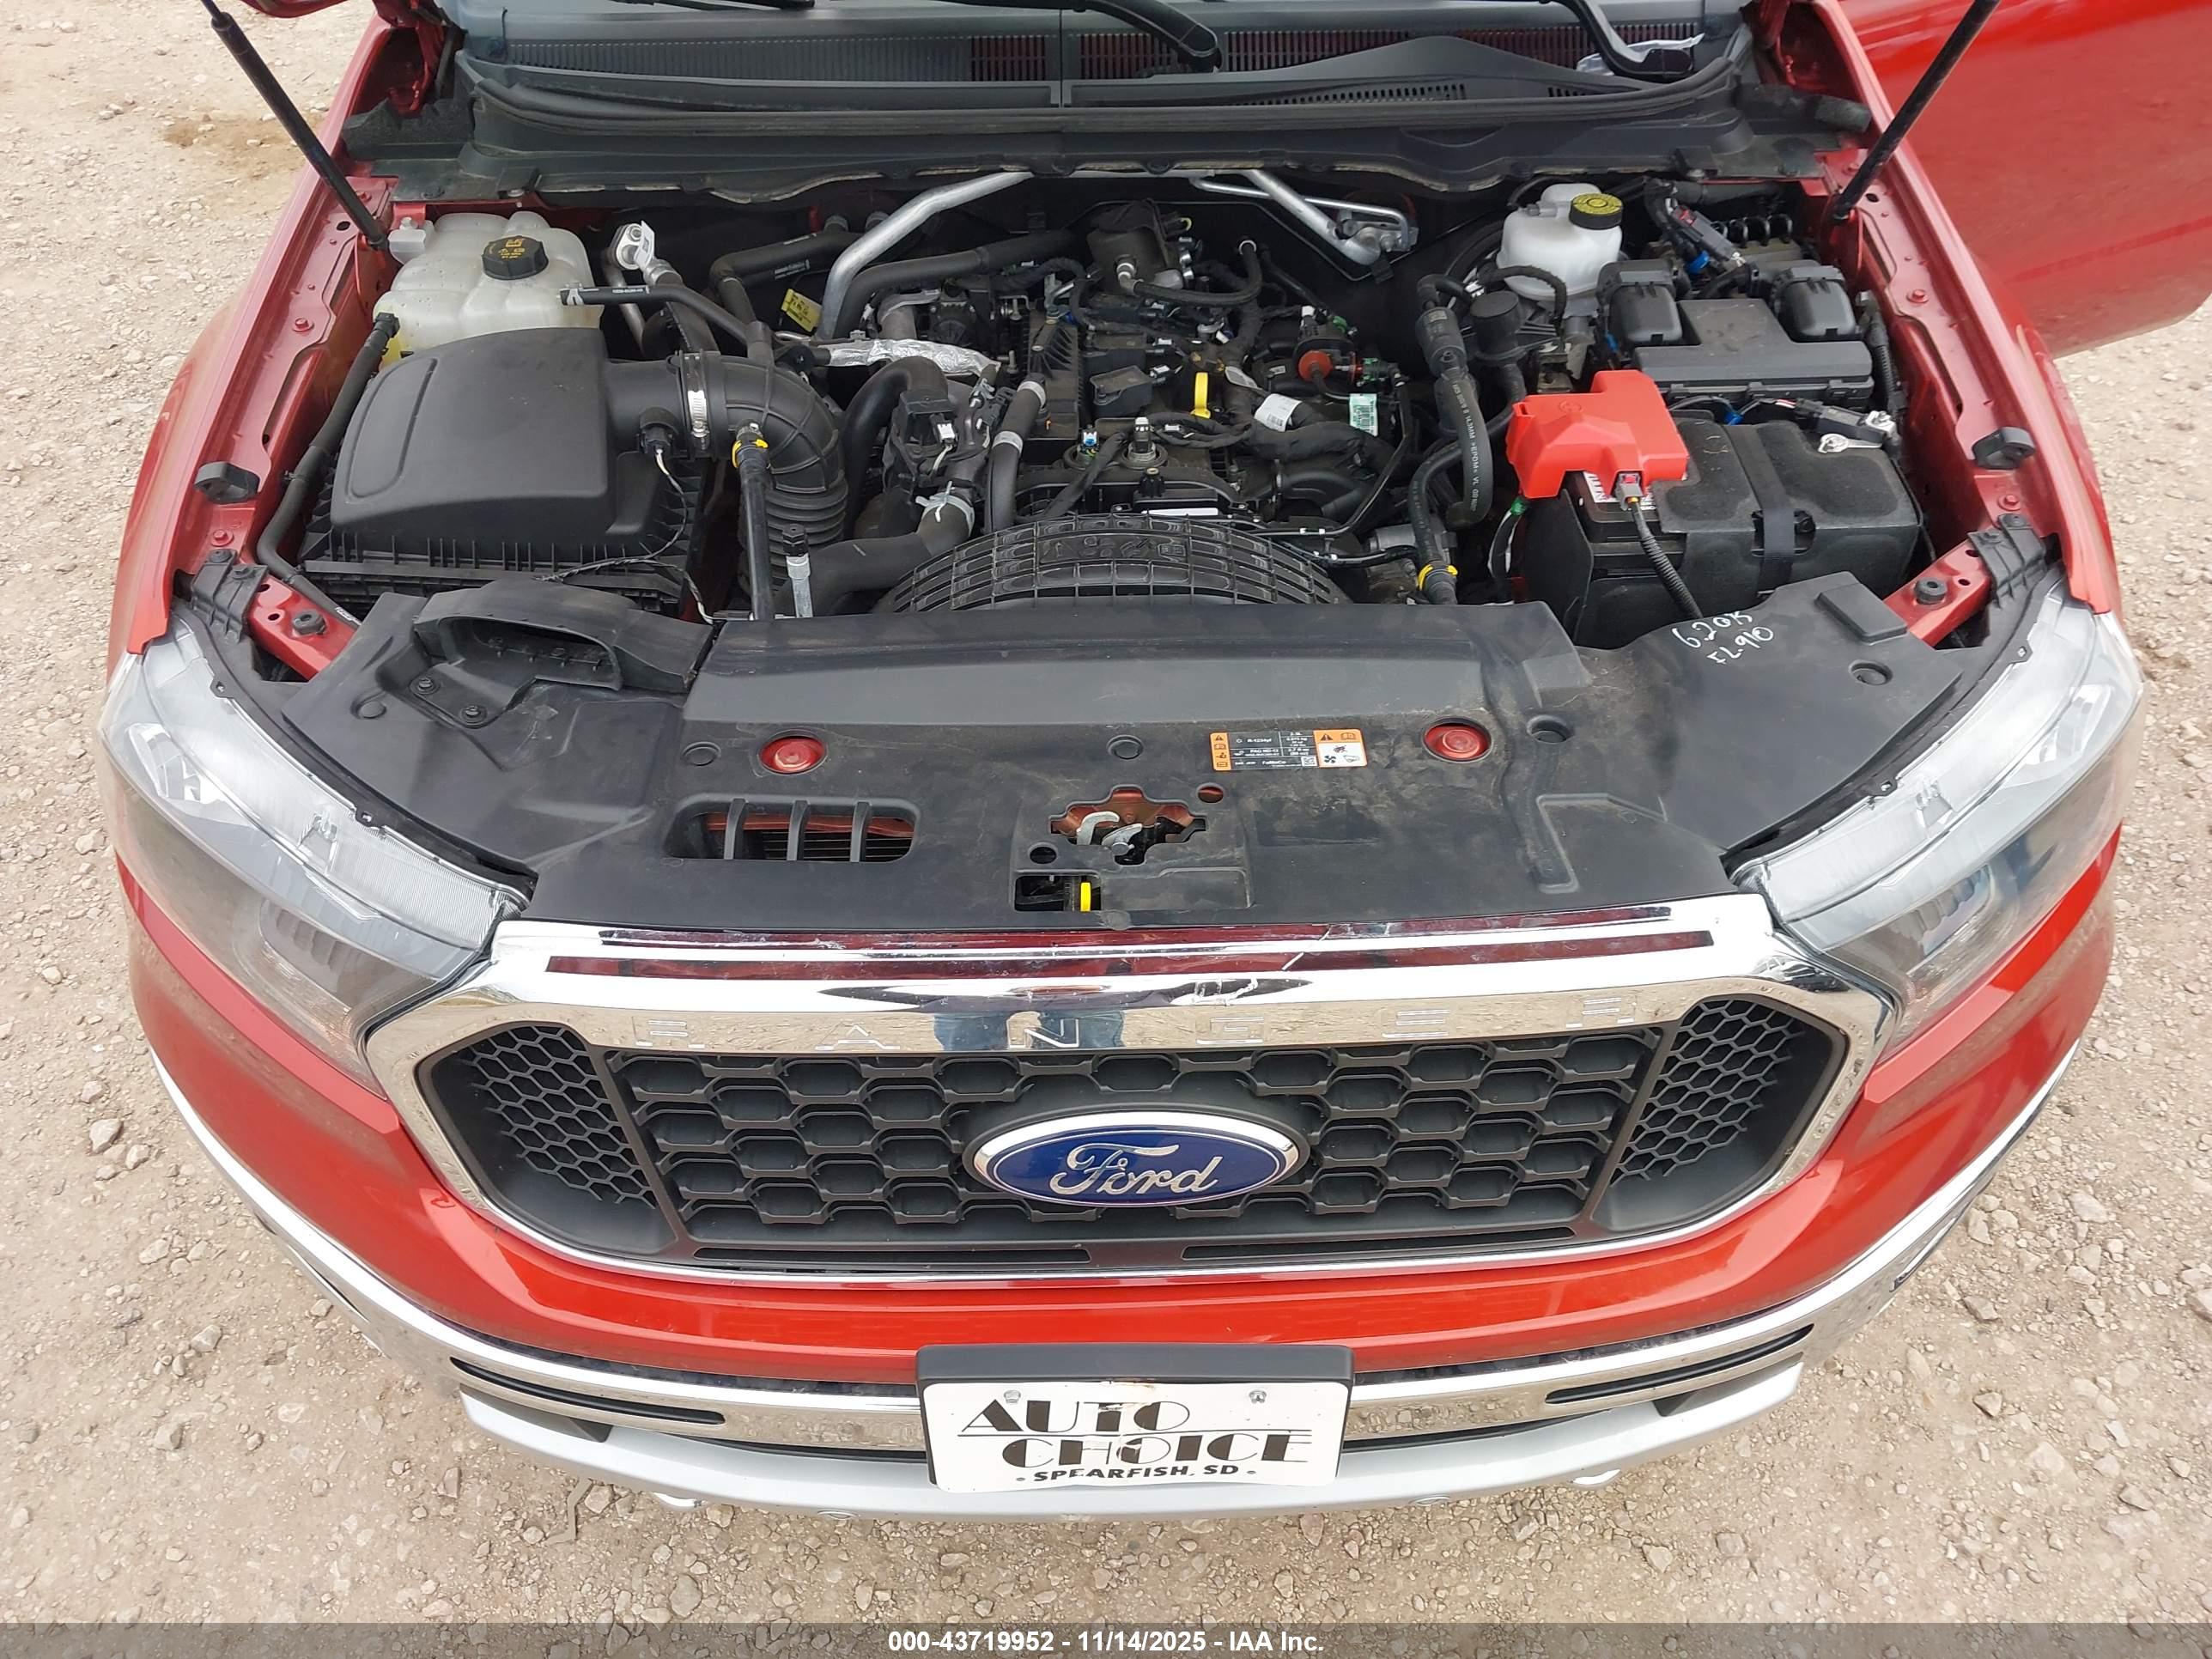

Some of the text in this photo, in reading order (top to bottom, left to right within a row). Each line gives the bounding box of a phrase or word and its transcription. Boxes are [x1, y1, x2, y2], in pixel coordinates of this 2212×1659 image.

[1049, 1143, 1224, 1194] Ford
[961, 1399, 1191, 1433] AUTO
[1002, 1433, 1313, 1468] CHOICE
[1203, 1464, 1239, 1475] SD
